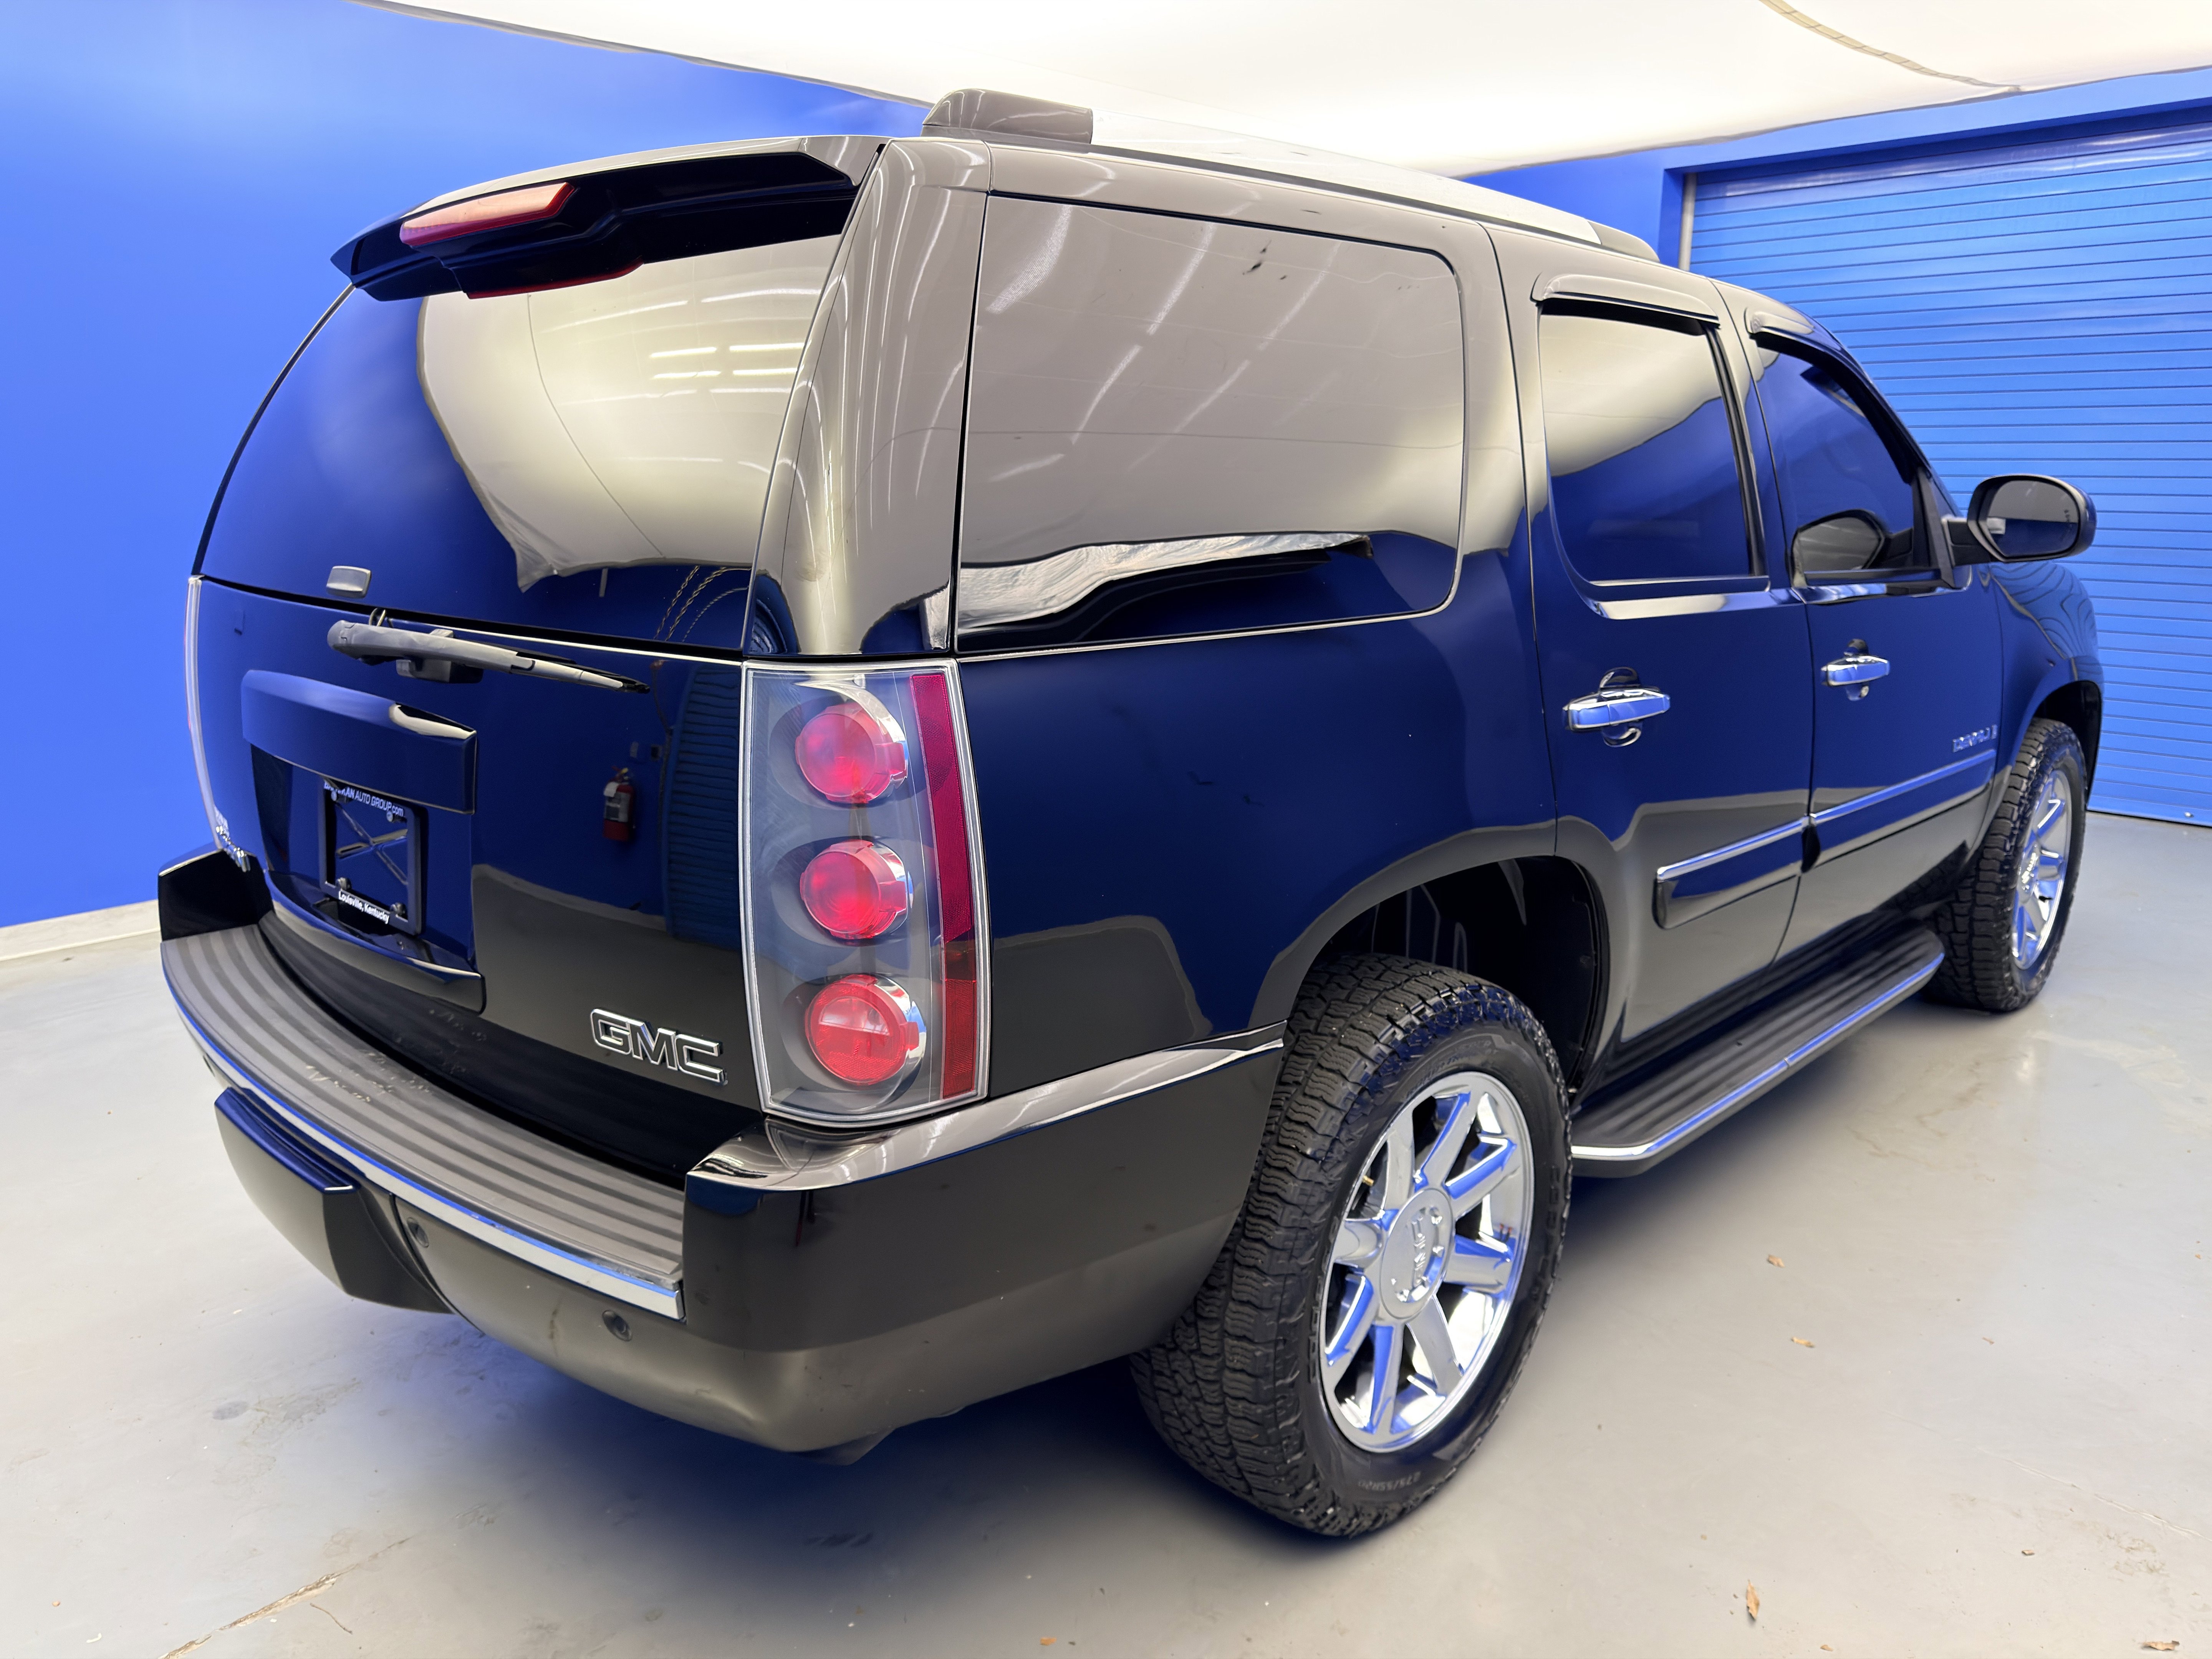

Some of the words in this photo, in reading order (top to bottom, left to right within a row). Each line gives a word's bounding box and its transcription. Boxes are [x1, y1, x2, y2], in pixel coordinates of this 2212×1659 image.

[355, 790, 371, 804] AUTO
[338, 890, 364, 912] Louisville,
[364, 903, 389, 924] Kentucky
[590, 1008, 728, 1085] GMC
